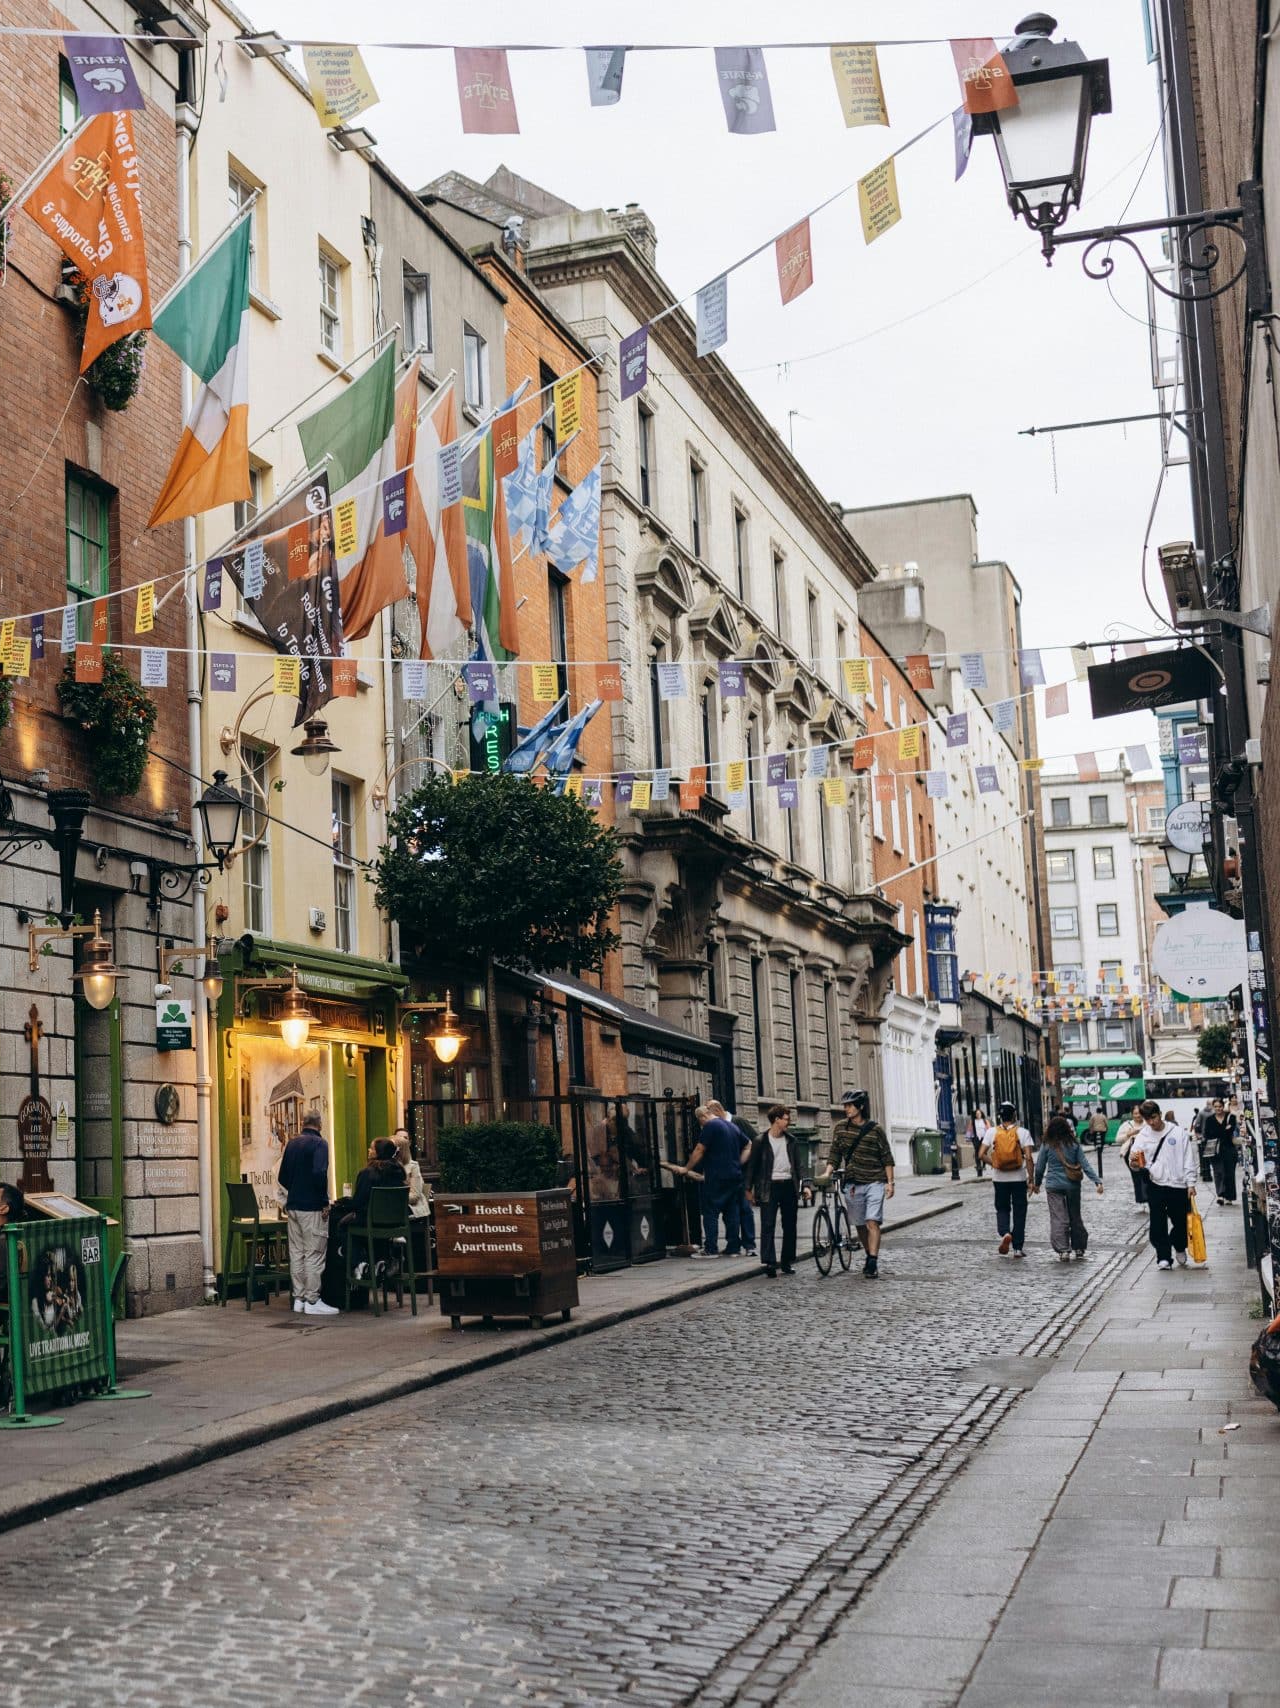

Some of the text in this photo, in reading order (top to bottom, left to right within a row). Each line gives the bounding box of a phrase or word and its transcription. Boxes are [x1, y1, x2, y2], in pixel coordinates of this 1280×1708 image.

[42, 201, 54, 216] &
[107, 182, 134, 243] Welcomes
[781, 250, 810, 277] STATE
[495, 436, 518, 457] STATE
[384, 487, 405, 502] K-STATE
[289, 544, 308, 559] STATE
[30, 1125, 43, 1133] LIVE
[250, 1171, 261, 1185] The
[474, 1204, 525, 1215] Hostel &
[457, 1223, 518, 1234] Penthouse
[453, 1241, 523, 1254] Apartments
[83, 1248, 99, 1264] BAR
[29, 1331, 90, 1358] LIVE TRADITIONAL MUSIC
